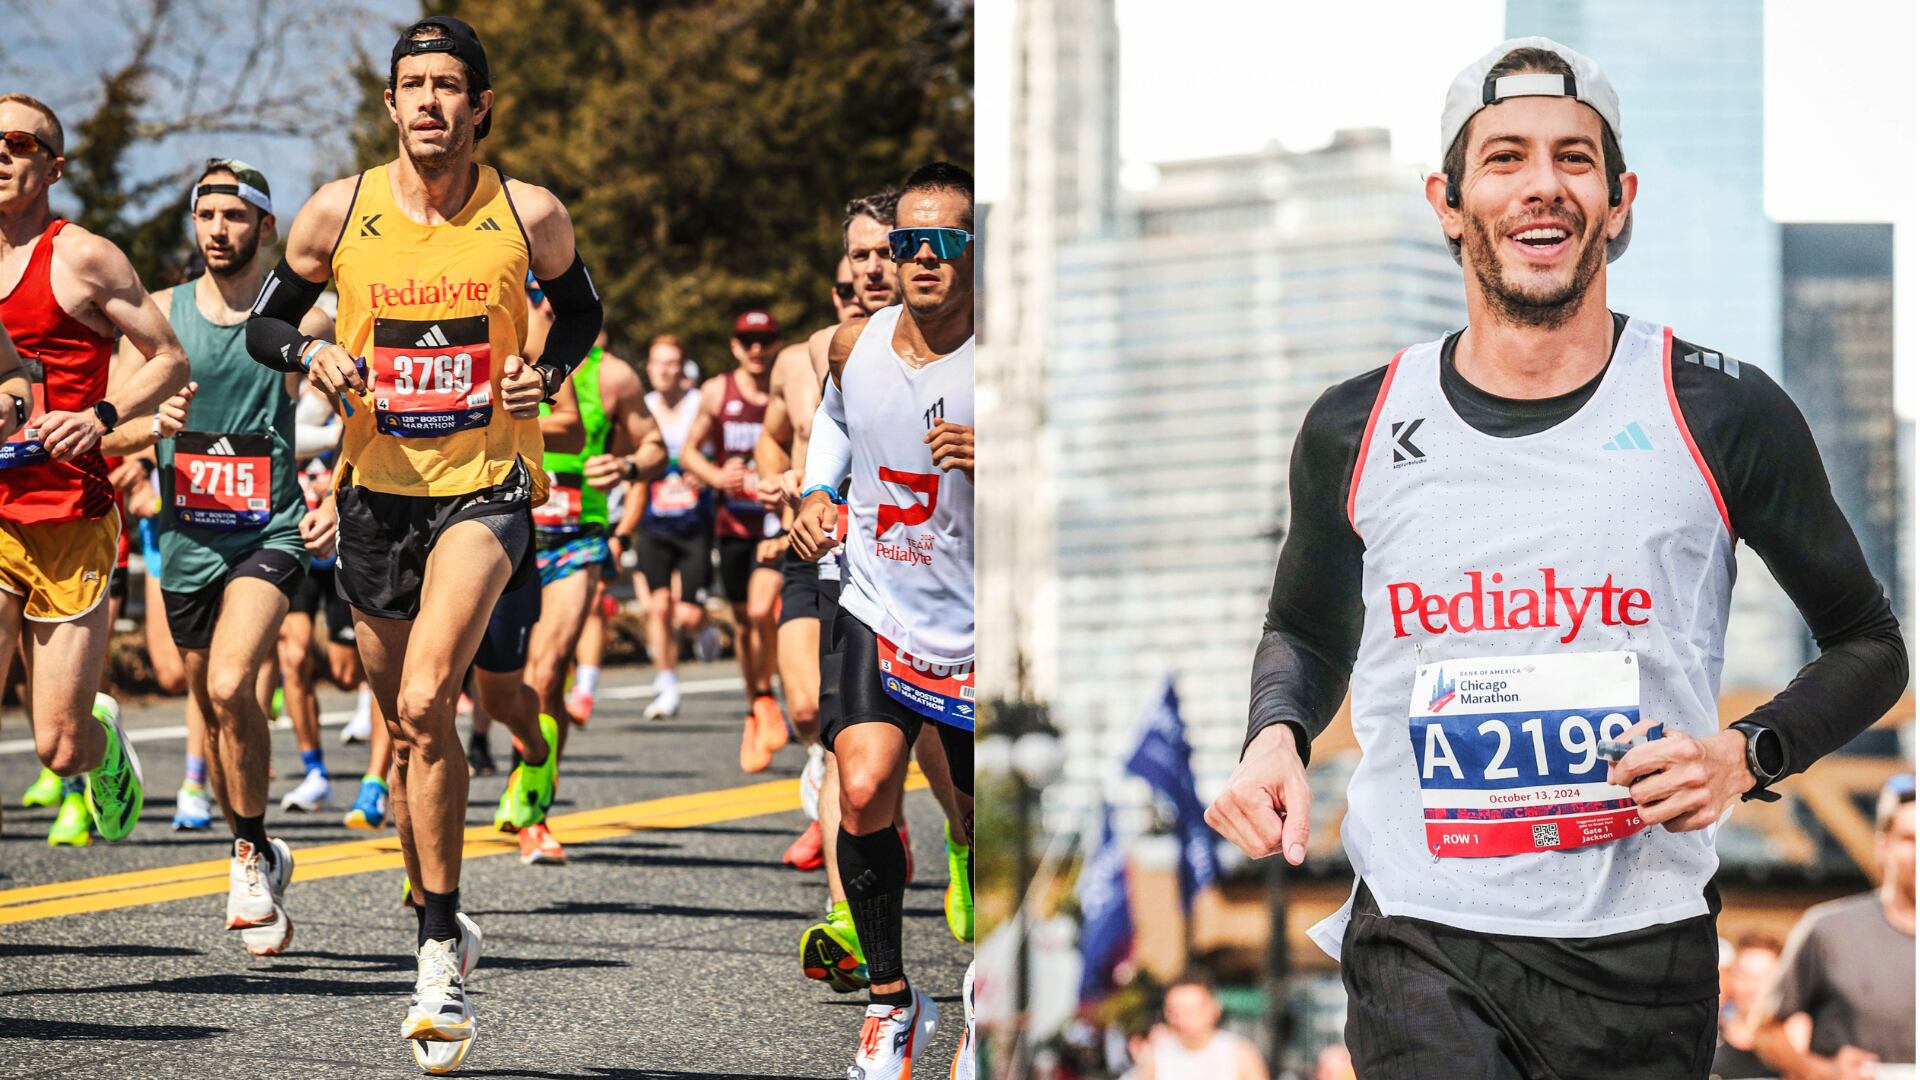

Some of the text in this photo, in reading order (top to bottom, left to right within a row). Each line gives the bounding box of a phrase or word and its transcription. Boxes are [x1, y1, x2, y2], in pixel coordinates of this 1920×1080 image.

[367, 275, 490, 309] Pedialyte
[393, 352, 473, 396] 3769
[379, 400, 387, 409] 4
[420, 414, 455, 423] BOSTON
[402, 421, 457, 430] MARATHON
[190, 459, 254, 497] 2715
[194, 517, 237, 525] MARATHON
[906, 537, 934, 550] TEAM
[876, 542, 932, 566] Pedialyte
[1386, 567, 1652, 644] Pedialyte
[883, 660, 889, 670] 3
[1489, 668, 1521, 676] AMERICA
[1460, 680, 1508, 693] Chicago
[901, 690, 946, 712] MARATHON
[914, 689, 945, 705] BOSTON
[1460, 692, 1520, 705] Marathon
[1422, 723, 1465, 780] A
[1489, 788, 1580, 803] October 13, 2024
[1625, 816, 1640, 827] 16
[1582, 832, 1614, 843] Jackson
[1583, 827, 1602, 835] Gate
[1443, 833, 1479, 844] ROW 1
